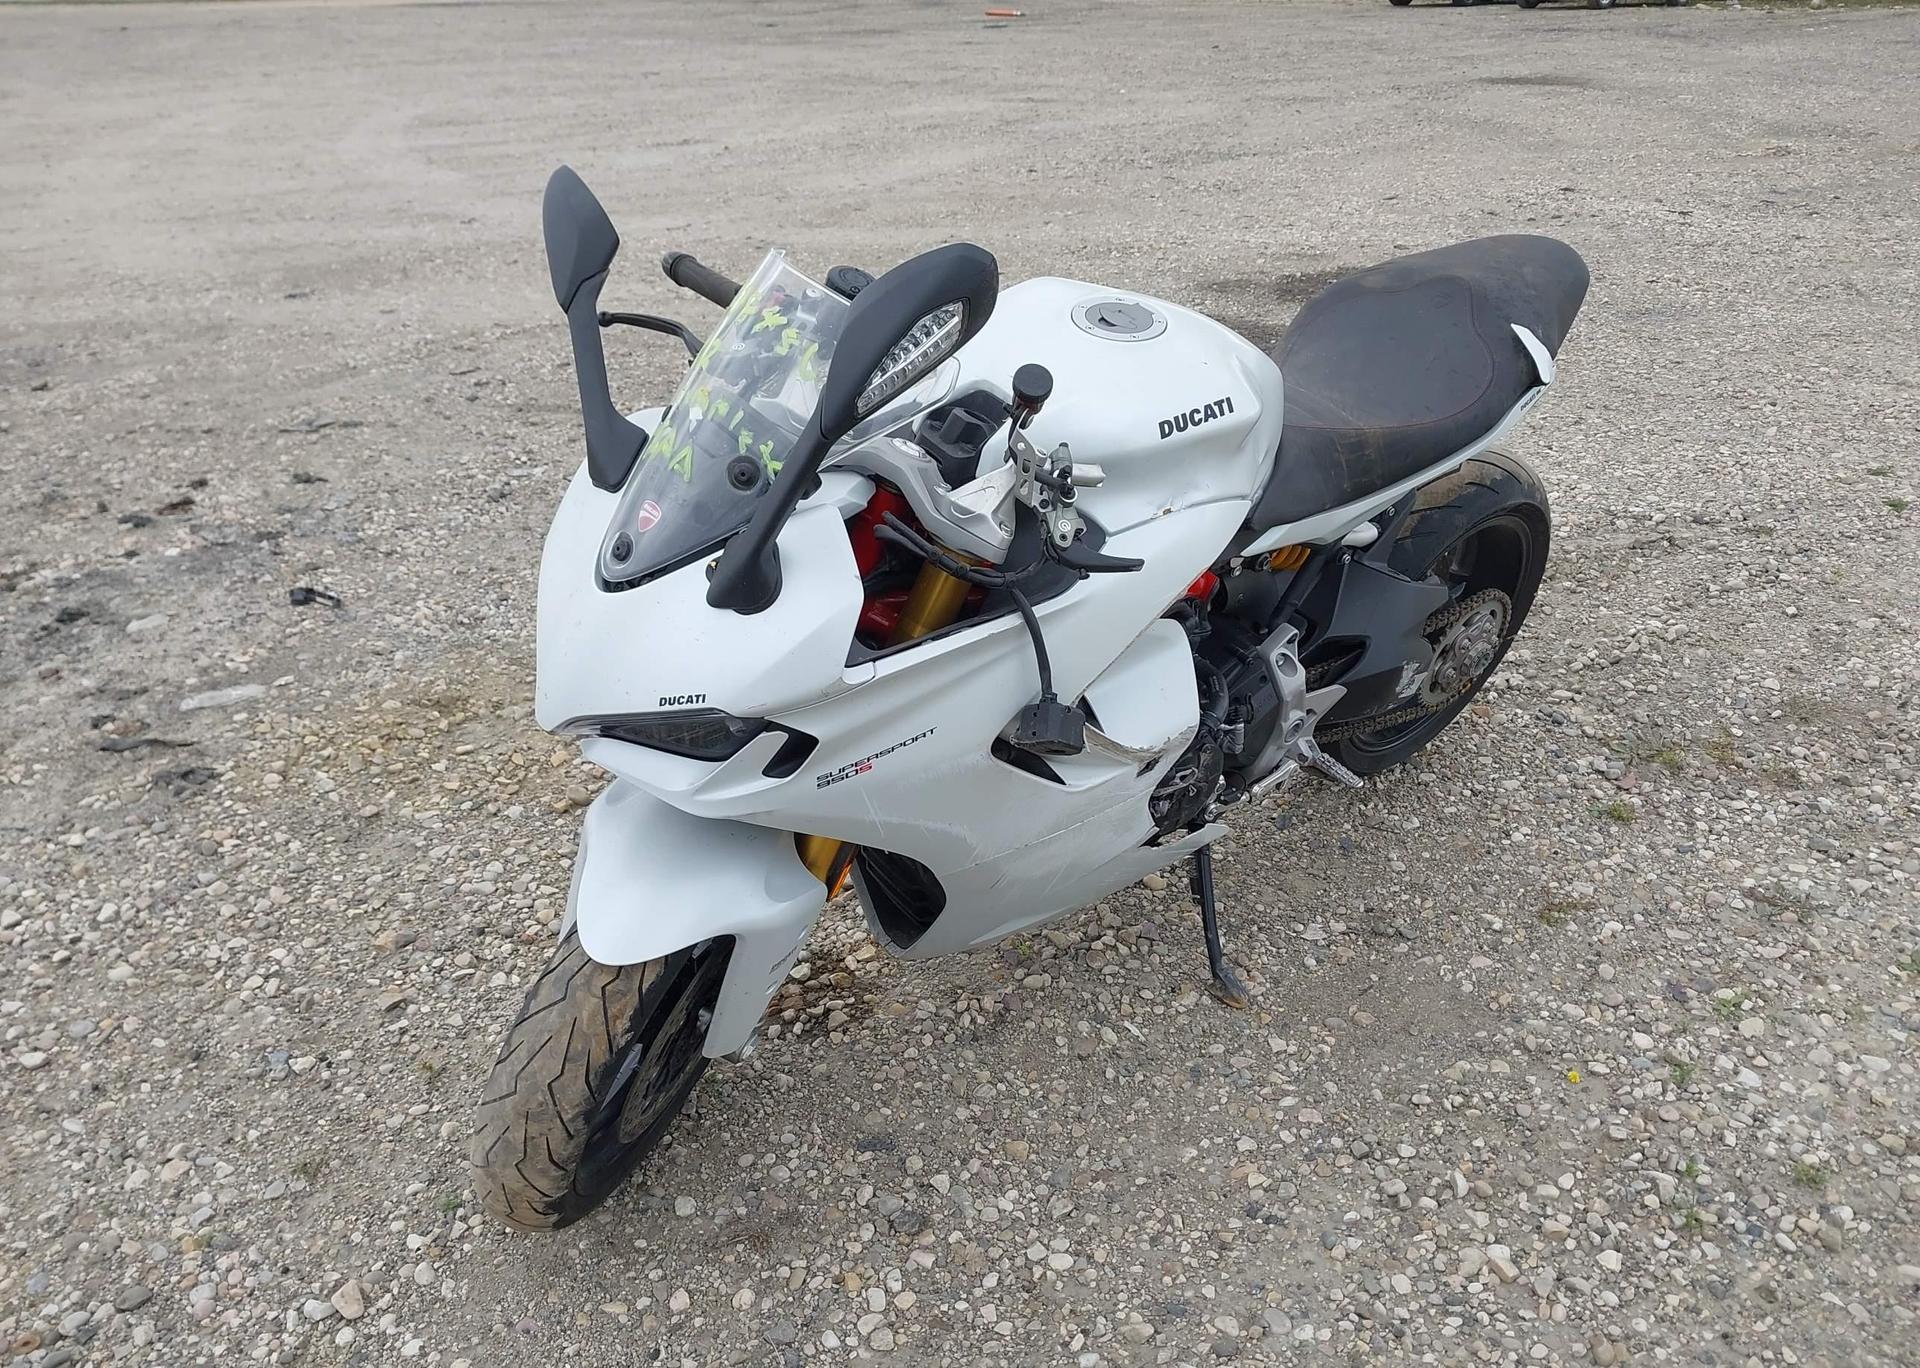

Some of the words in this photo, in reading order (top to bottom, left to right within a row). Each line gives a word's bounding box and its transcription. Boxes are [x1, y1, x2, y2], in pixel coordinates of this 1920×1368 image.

[1158, 396, 1234, 440] DUCATI
[659, 694, 707, 707] DUCATI
[816, 726, 938, 783] SUPERSPORT
[816, 762, 873, 790] 950S
